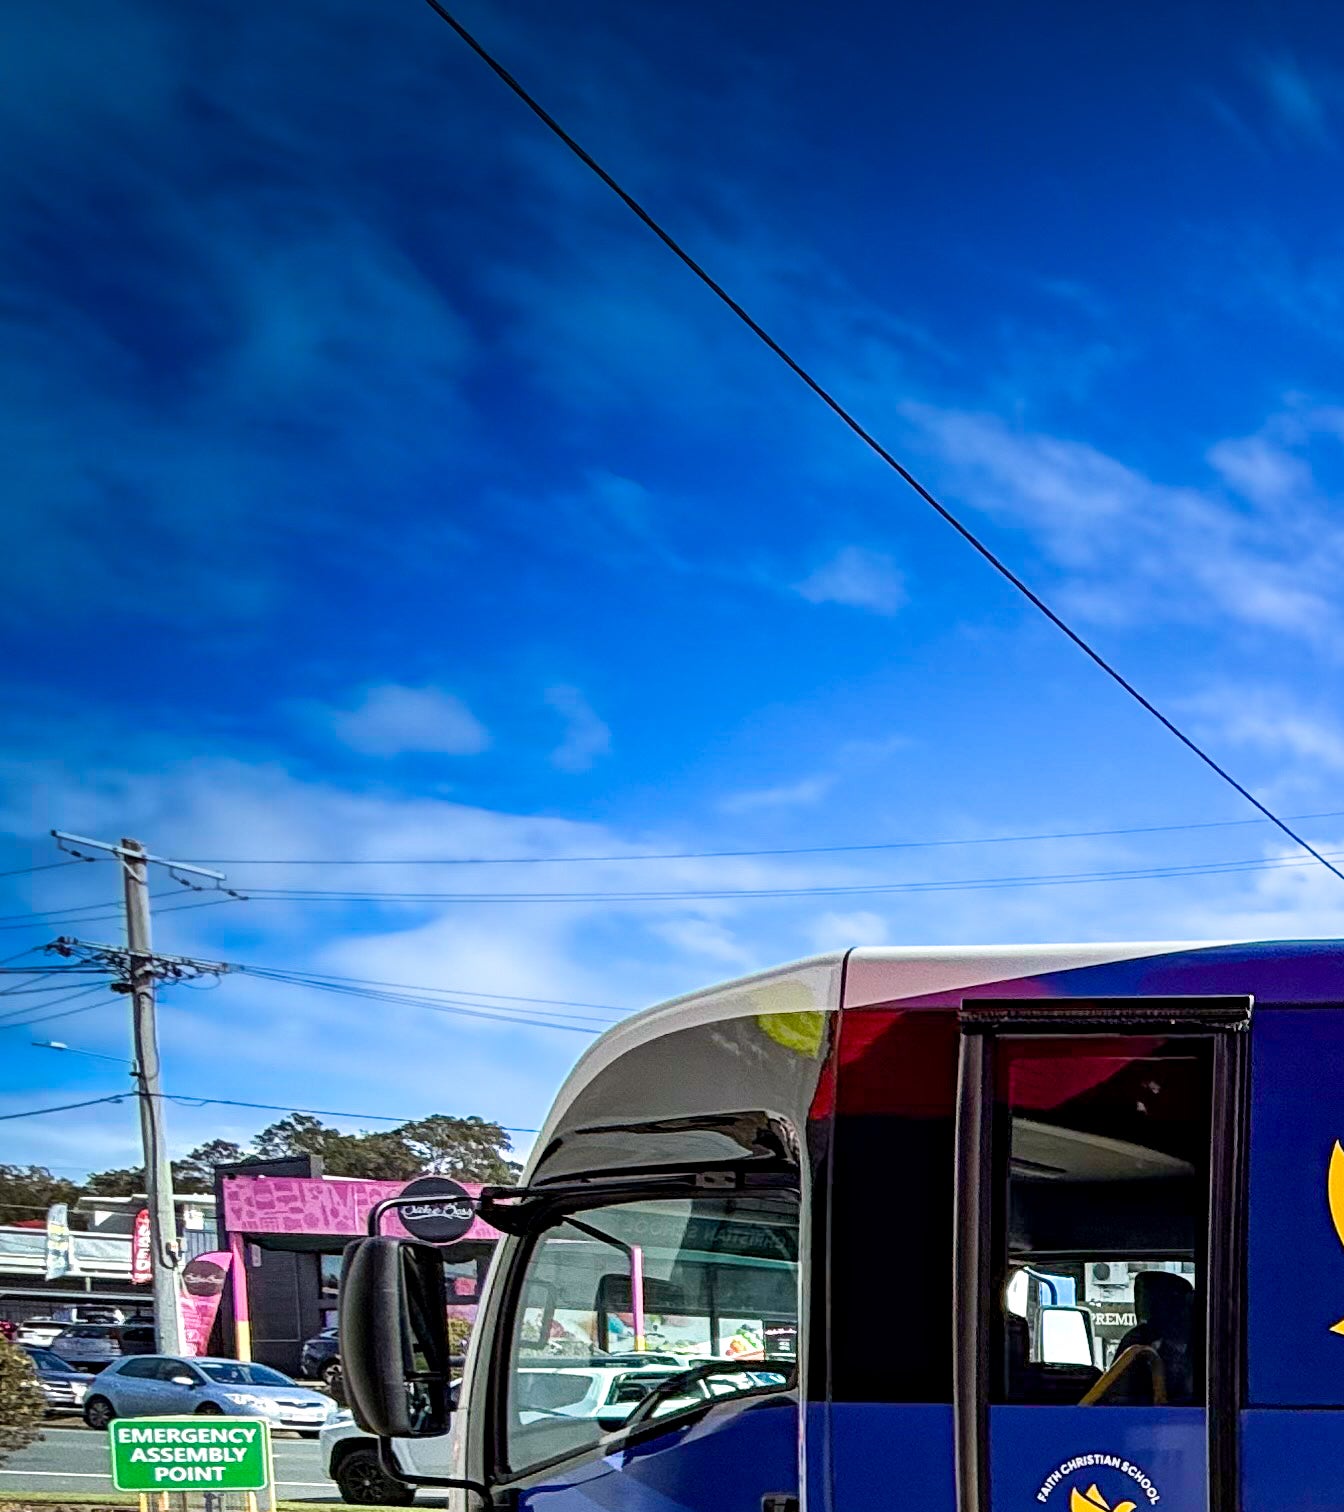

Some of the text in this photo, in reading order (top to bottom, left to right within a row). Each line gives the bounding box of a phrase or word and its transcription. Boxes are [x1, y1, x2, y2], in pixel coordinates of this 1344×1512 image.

[118, 1428, 257, 1444] EMERGENCY
[130, 1447, 247, 1463] ASSEMBLY
[154, 1466, 226, 1482] POINT
[1036, 1453, 1161, 1505] FAITH CHRISTIAN SCHOOL
